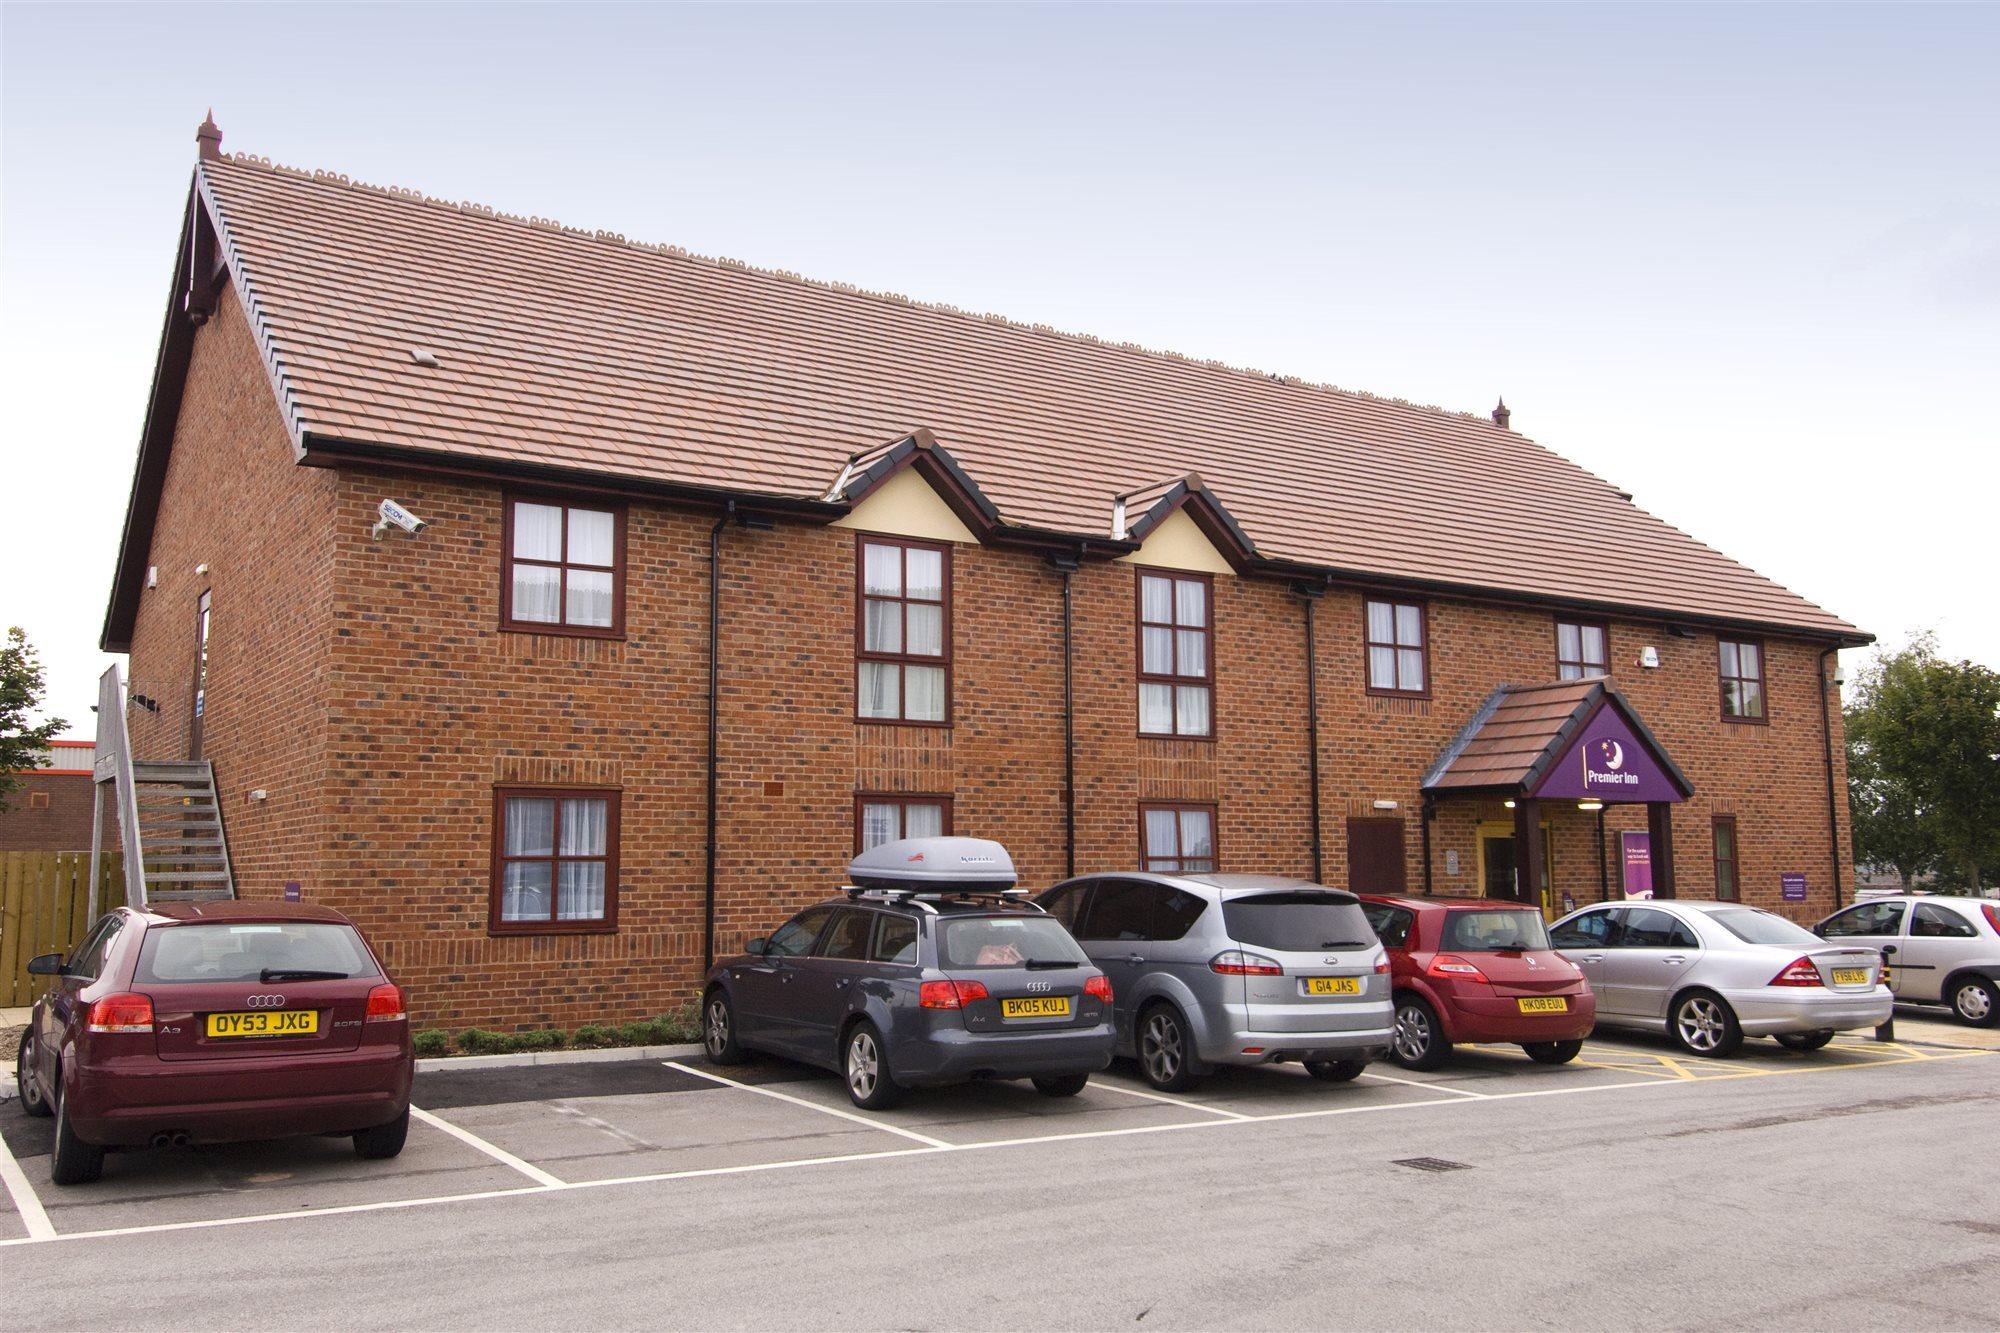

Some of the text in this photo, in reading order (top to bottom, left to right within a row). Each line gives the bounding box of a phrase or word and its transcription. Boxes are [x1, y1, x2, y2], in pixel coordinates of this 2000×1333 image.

[1588, 769, 1639, 785] Premier Inn
[1315, 981, 1332, 992] G14
[1007, 999, 1065, 1014] BK05 KUJ
[1522, 999, 1547, 1011] HK08
[216, 1013, 310, 1033] OY53 JXG
[161, 1026, 181, 1034] A3
